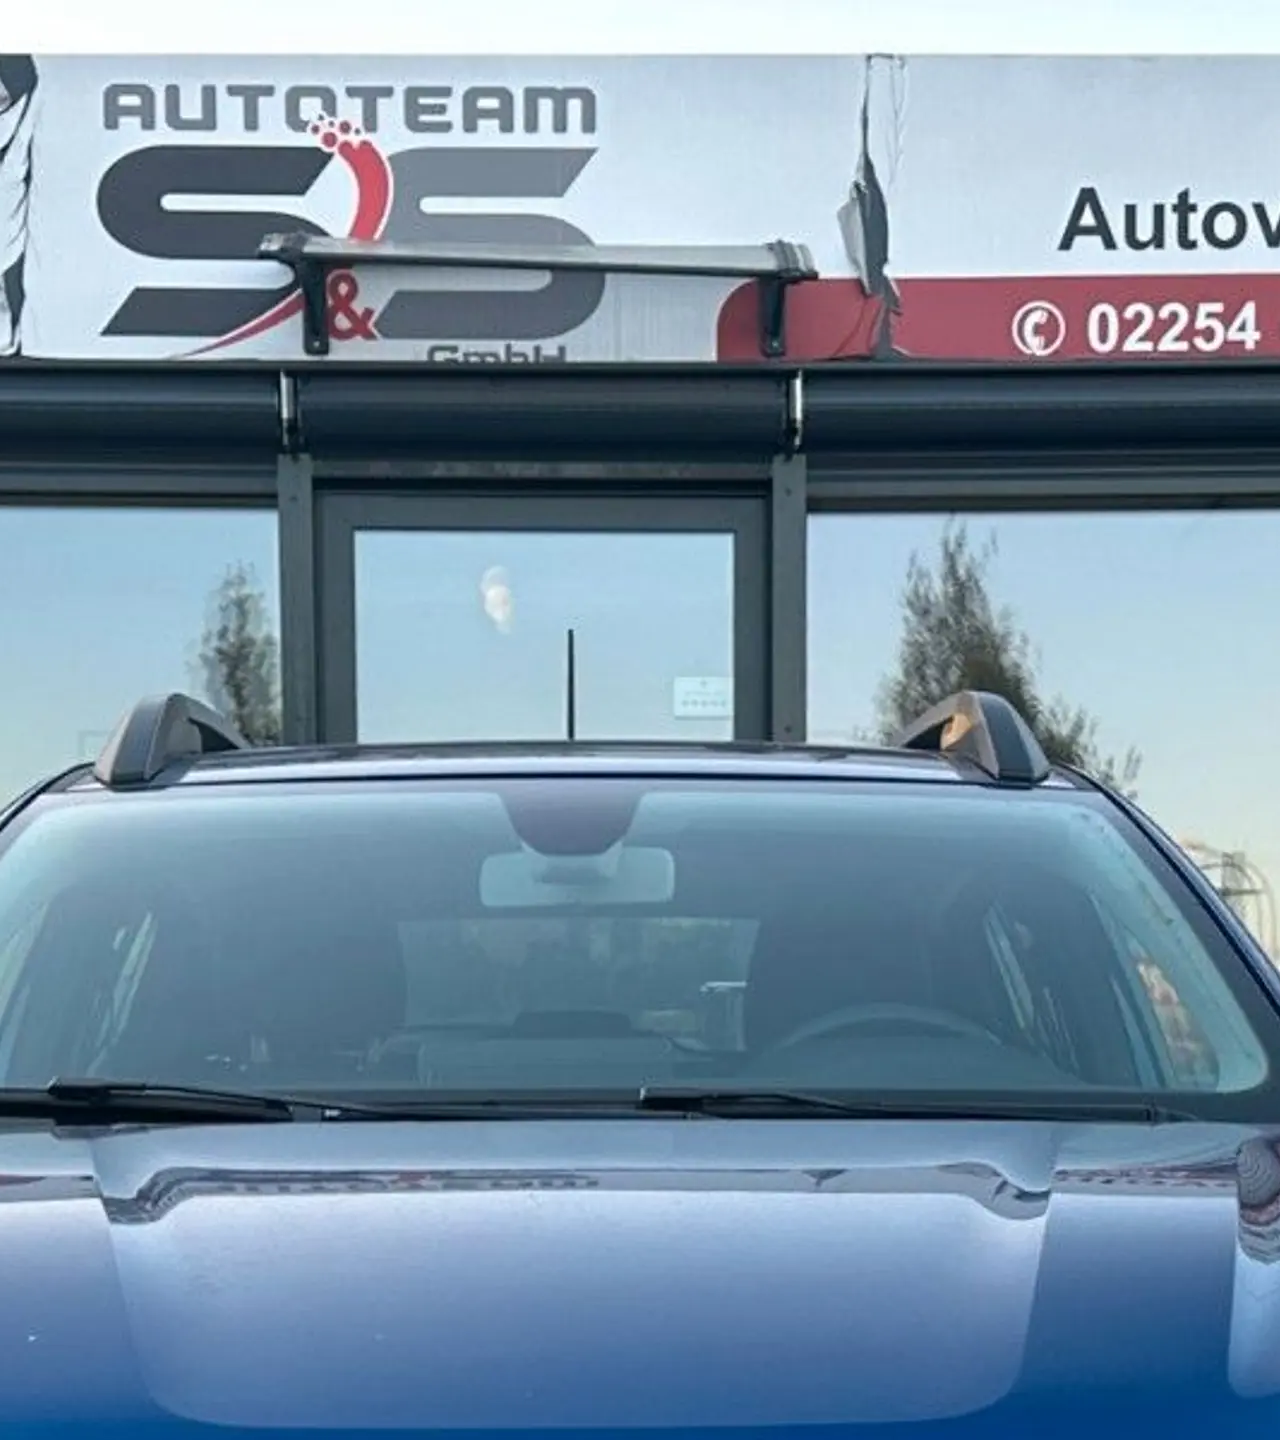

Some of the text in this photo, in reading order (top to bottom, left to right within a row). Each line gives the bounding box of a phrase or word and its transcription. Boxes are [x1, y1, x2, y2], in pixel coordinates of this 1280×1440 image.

[102, 84, 598, 134] AUTOTEAM
[1088, 301, 1261, 352] 02254
[427, 342, 567, 362] GmbH
